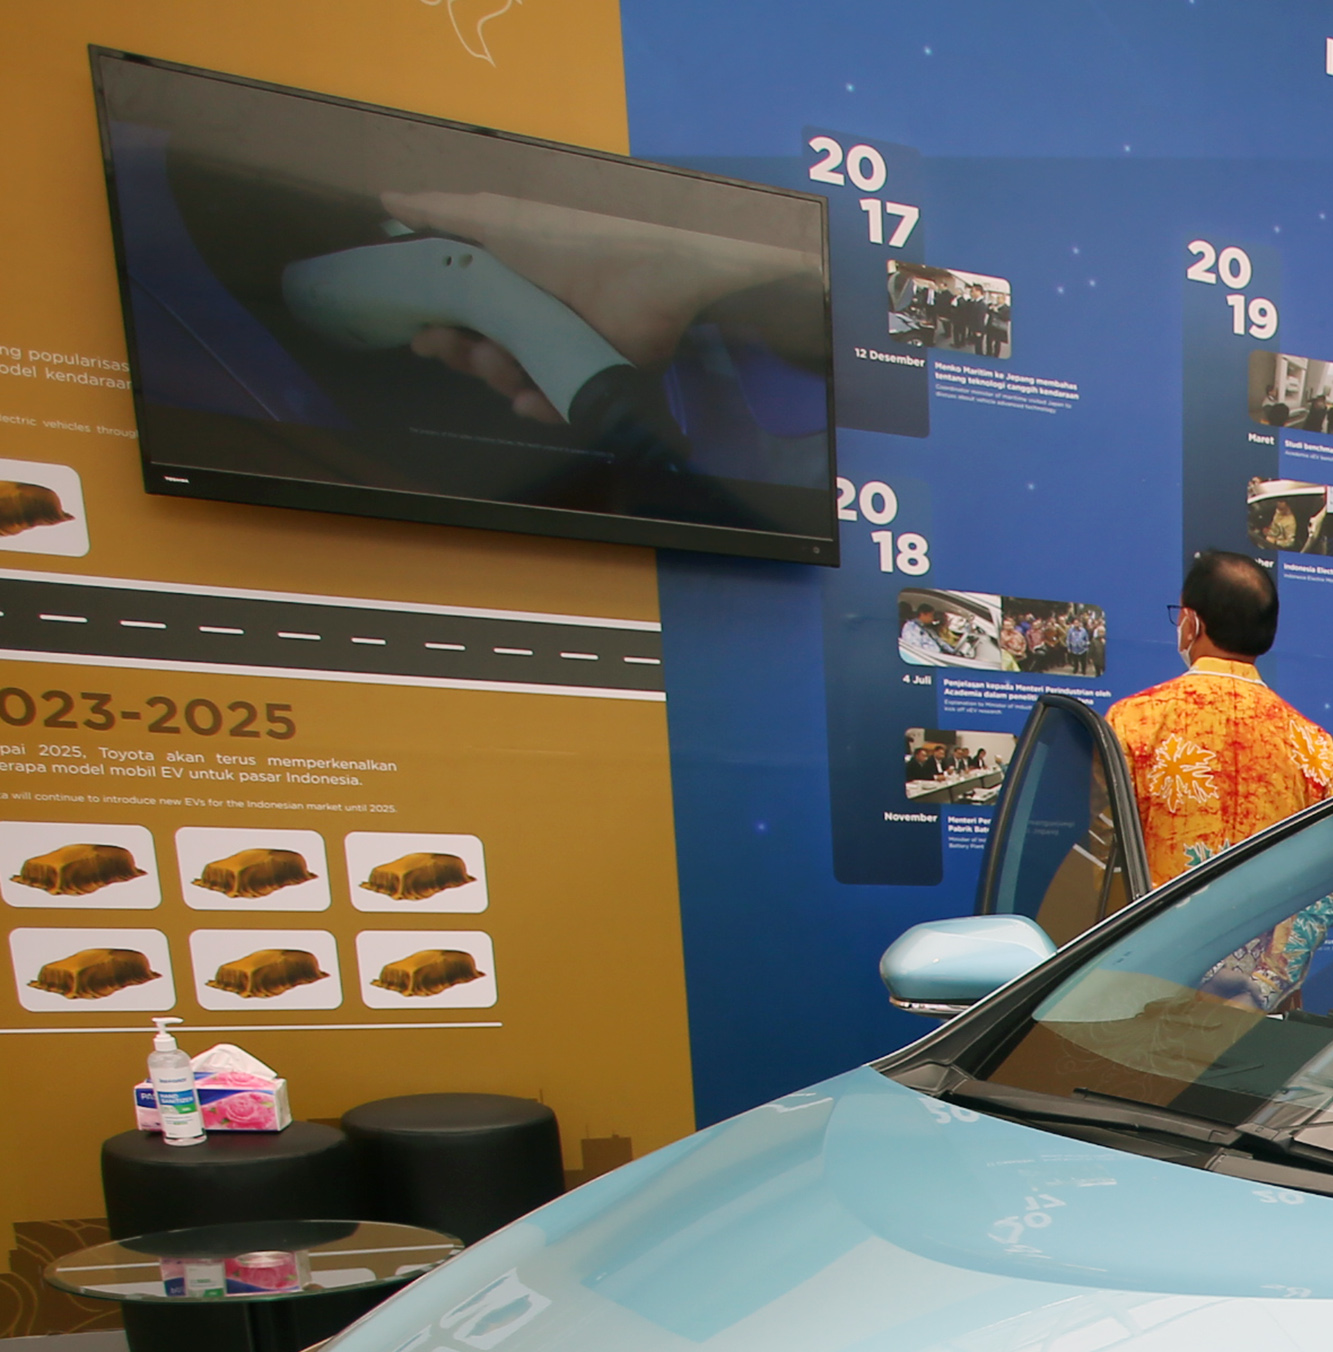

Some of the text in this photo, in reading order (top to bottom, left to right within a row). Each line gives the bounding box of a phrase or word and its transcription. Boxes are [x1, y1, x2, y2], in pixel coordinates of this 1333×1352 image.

[809, 137, 886, 191] 20
[860, 199, 919, 247] 17
[1187, 240, 1251, 289] 20
[1226, 294, 1277, 339] 19
[855, 348, 925, 367] 12 Desember
[1248, 433, 1274, 445] Maret
[838, 477, 897, 524] 20
[871, 531, 930, 575] 18
[903, 675, 932, 685] 4 Juli
[0, 687, 297, 740] 023-2025
[0, 744, 26, 756] pai
[98, 747, 155, 768] Toyota
[166, 750, 205, 764] akan
[216, 753, 256, 770] terus
[267, 757, 397, 771] memperkenalkan
[0, 762, 363, 786] erapa model mobil EV untuk pasar Indonesia.
[884, 812, 938, 822] November
